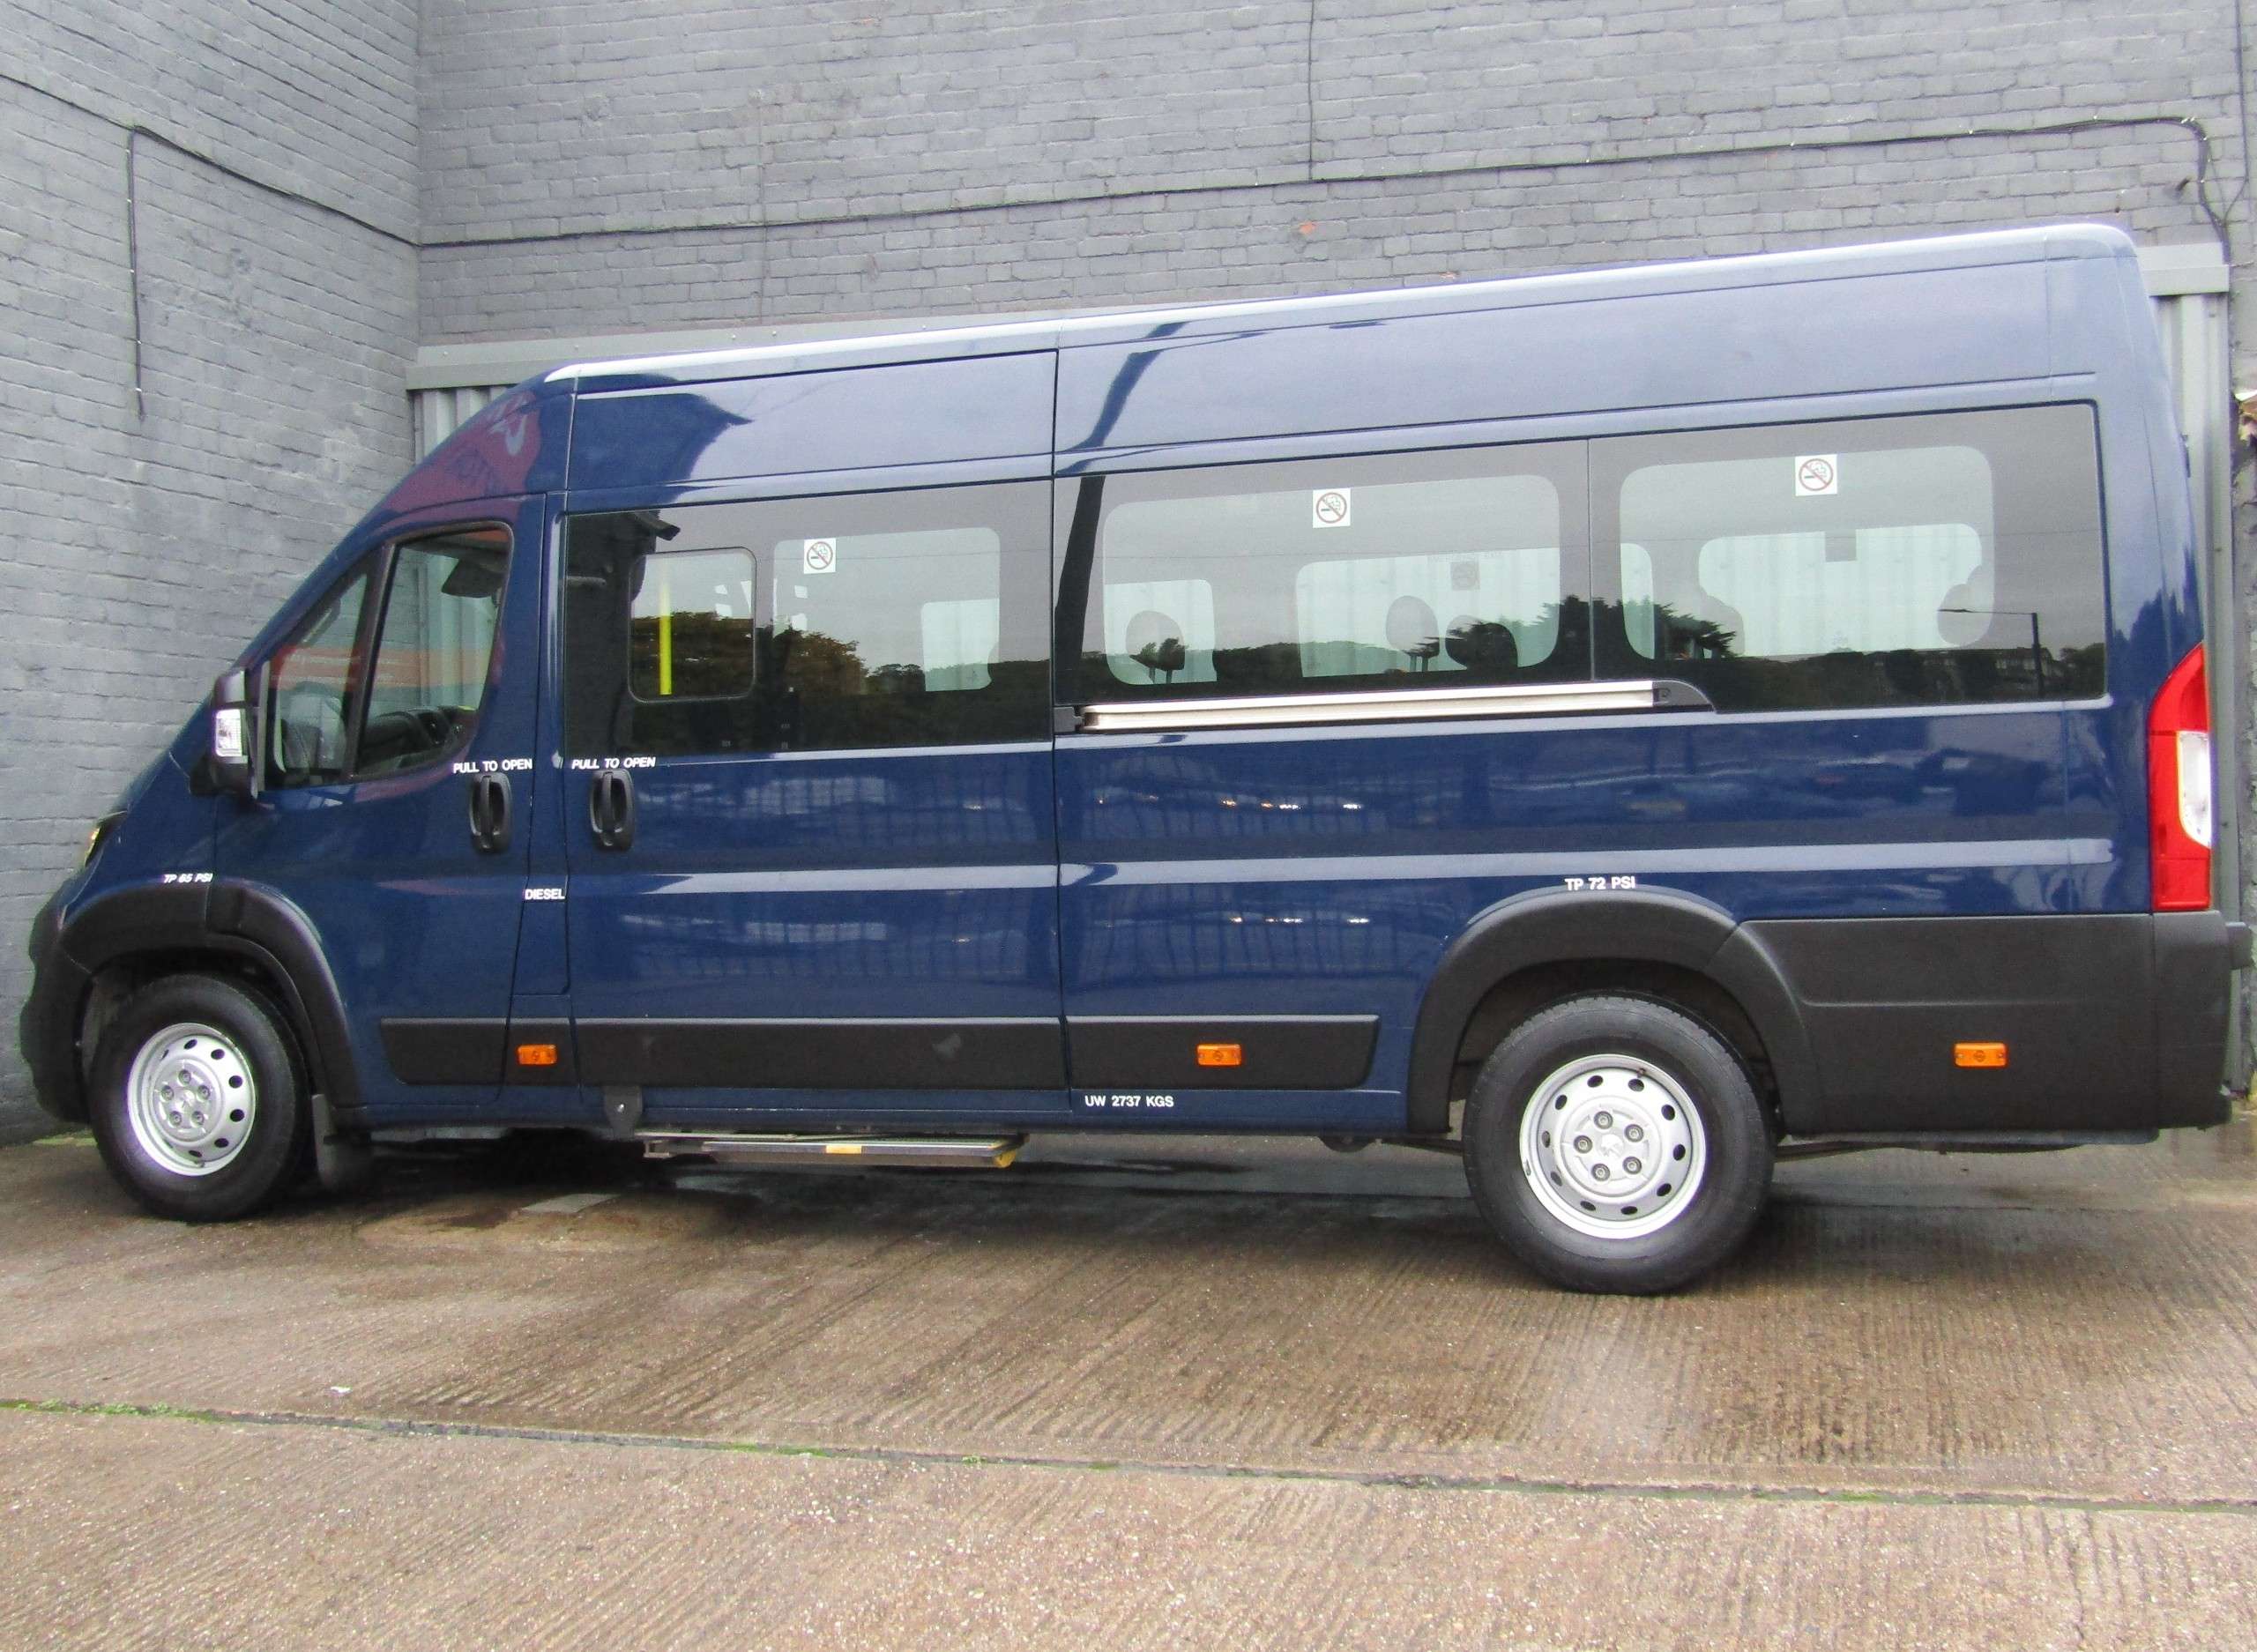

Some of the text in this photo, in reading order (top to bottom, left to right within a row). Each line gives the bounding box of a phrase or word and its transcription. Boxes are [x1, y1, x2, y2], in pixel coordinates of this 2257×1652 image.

[453, 759, 533, 774] PULL TO OPEN
[571, 757, 656, 770] PULL TO OPEN
[163, 874, 177, 883] TP
[194, 873, 213, 882] PSI
[1564, 875, 1636, 891] TP 72 PSI
[525, 889, 565, 900] DIESEL
[1084, 1095, 1174, 1108] UW 2737 KGS
